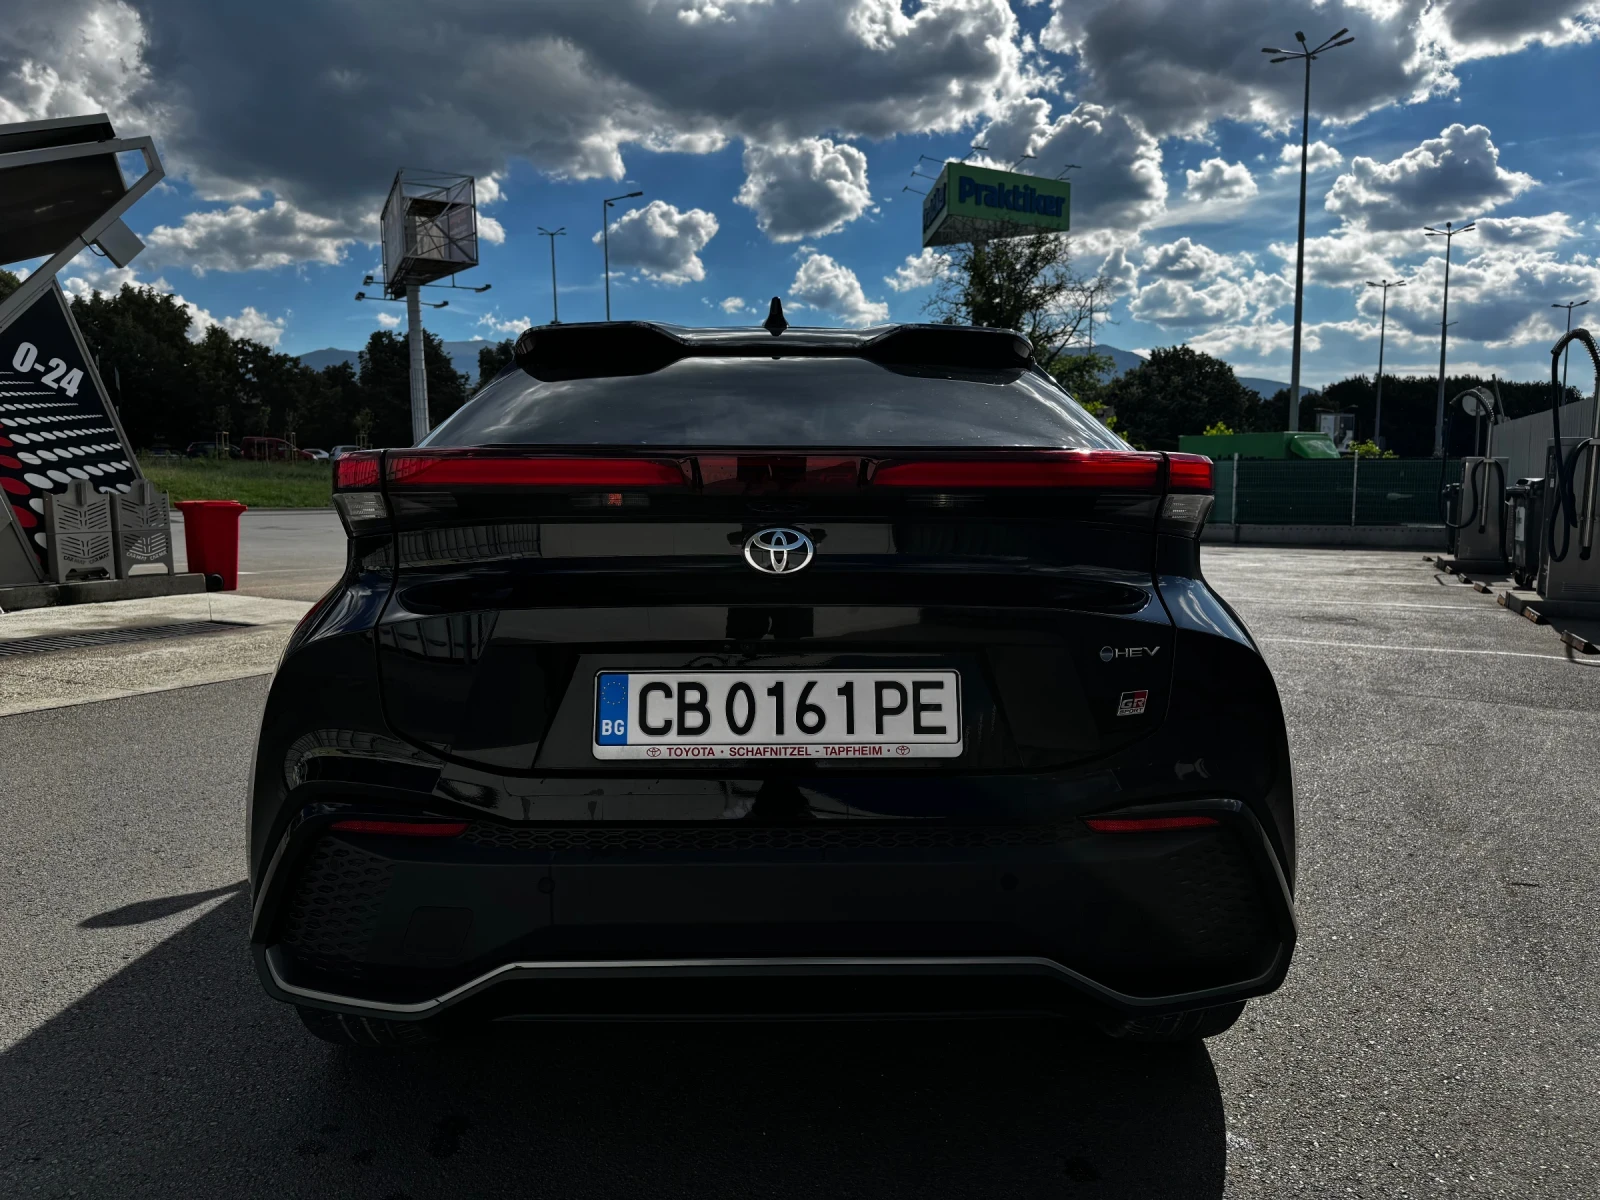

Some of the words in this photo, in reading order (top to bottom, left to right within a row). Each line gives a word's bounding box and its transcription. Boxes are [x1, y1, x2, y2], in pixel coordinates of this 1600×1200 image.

[959, 175, 1066, 218] Praktiker
[12, 342, 84, 398] 0-24
[1114, 646, 1160, 658] HEV
[638, 681, 711, 737] CB
[725, 681, 856, 736] 0161
[875, 681, 947, 735] PE
[1120, 698, 1146, 709] GR
[601, 719, 625, 736] BG
[666, 747, 716, 758] TOYOTA
[728, 746, 812, 757] SCHAFNITZEL
[823, 746, 883, 756] TAPFHEIM
